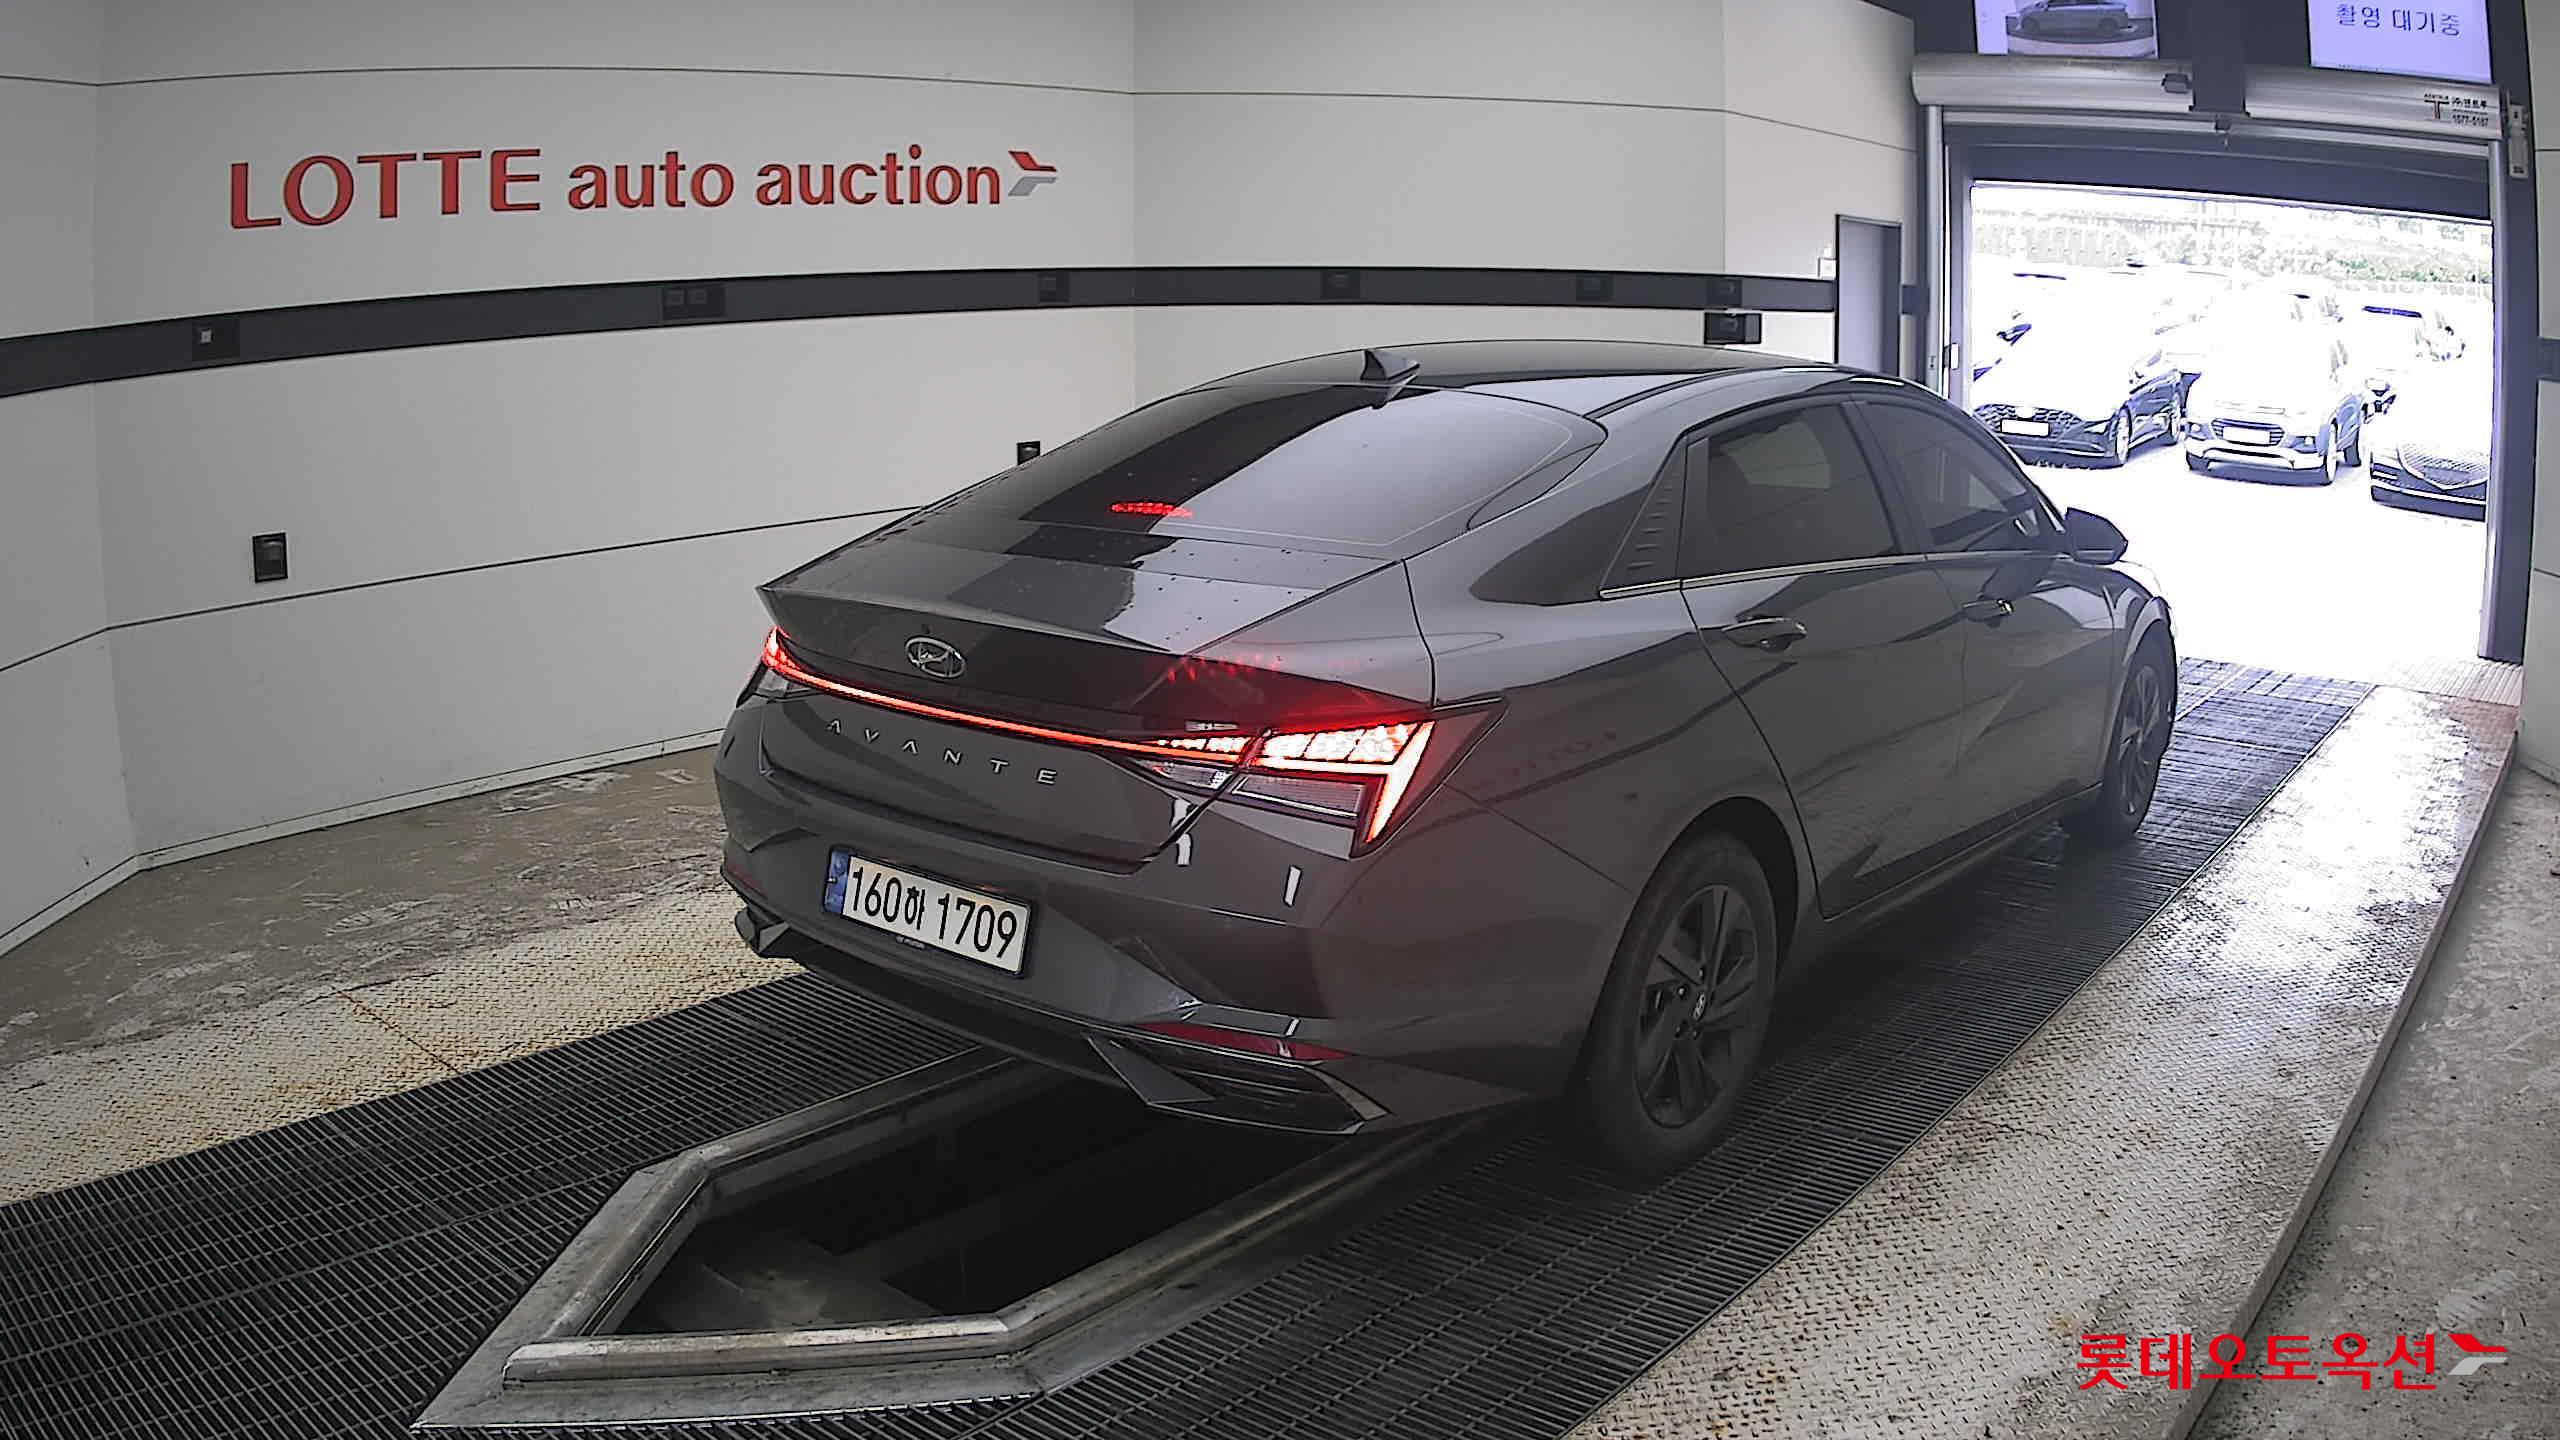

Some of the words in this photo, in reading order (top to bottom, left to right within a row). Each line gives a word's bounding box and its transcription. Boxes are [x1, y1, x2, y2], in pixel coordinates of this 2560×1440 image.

[2392, 9, 2460, 36] 대기중
[230, 148, 541, 229] LOTTE
[568, 151, 736, 209] auto
[755, 144, 1001, 206] auction
[827, 719, 1057, 785] AVANTE
[852, 866, 926, 931] 160하
[937, 893, 1018, 959] 1709
